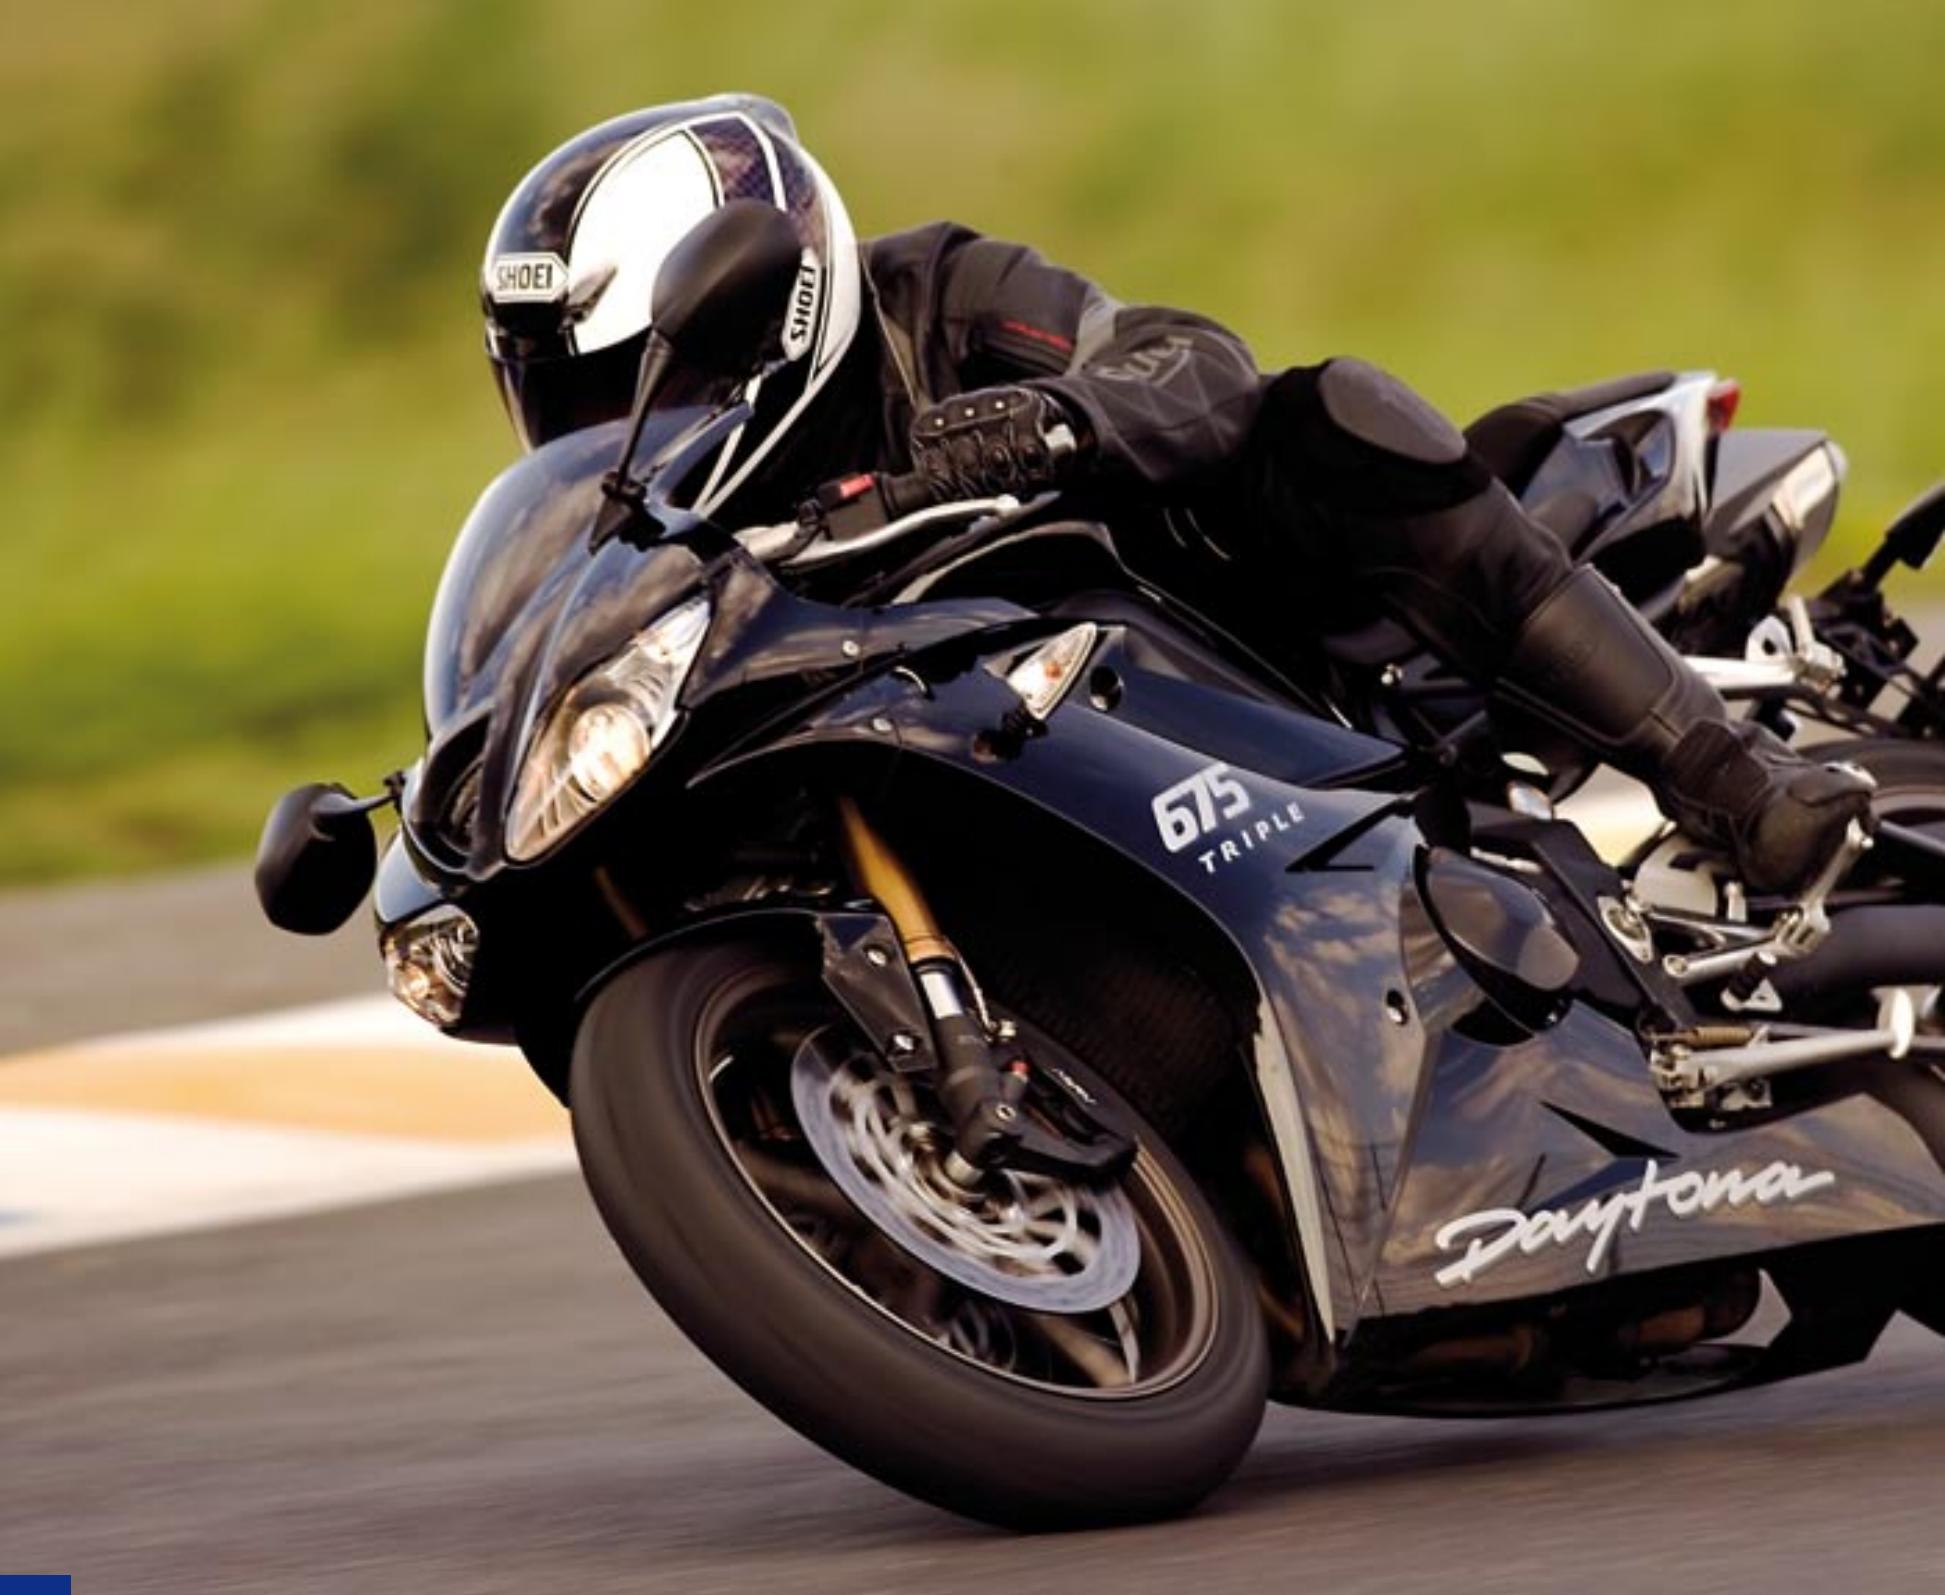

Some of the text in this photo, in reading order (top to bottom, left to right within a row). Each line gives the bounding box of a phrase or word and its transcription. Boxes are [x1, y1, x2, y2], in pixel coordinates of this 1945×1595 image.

[497, 263, 553, 291] SHOEI
[790, 265, 816, 342] SHOEI
[1152, 761, 1250, 853] 675
[1198, 801, 1305, 874] TRIPLE
[1433, 1159, 1836, 1286] Daytona
